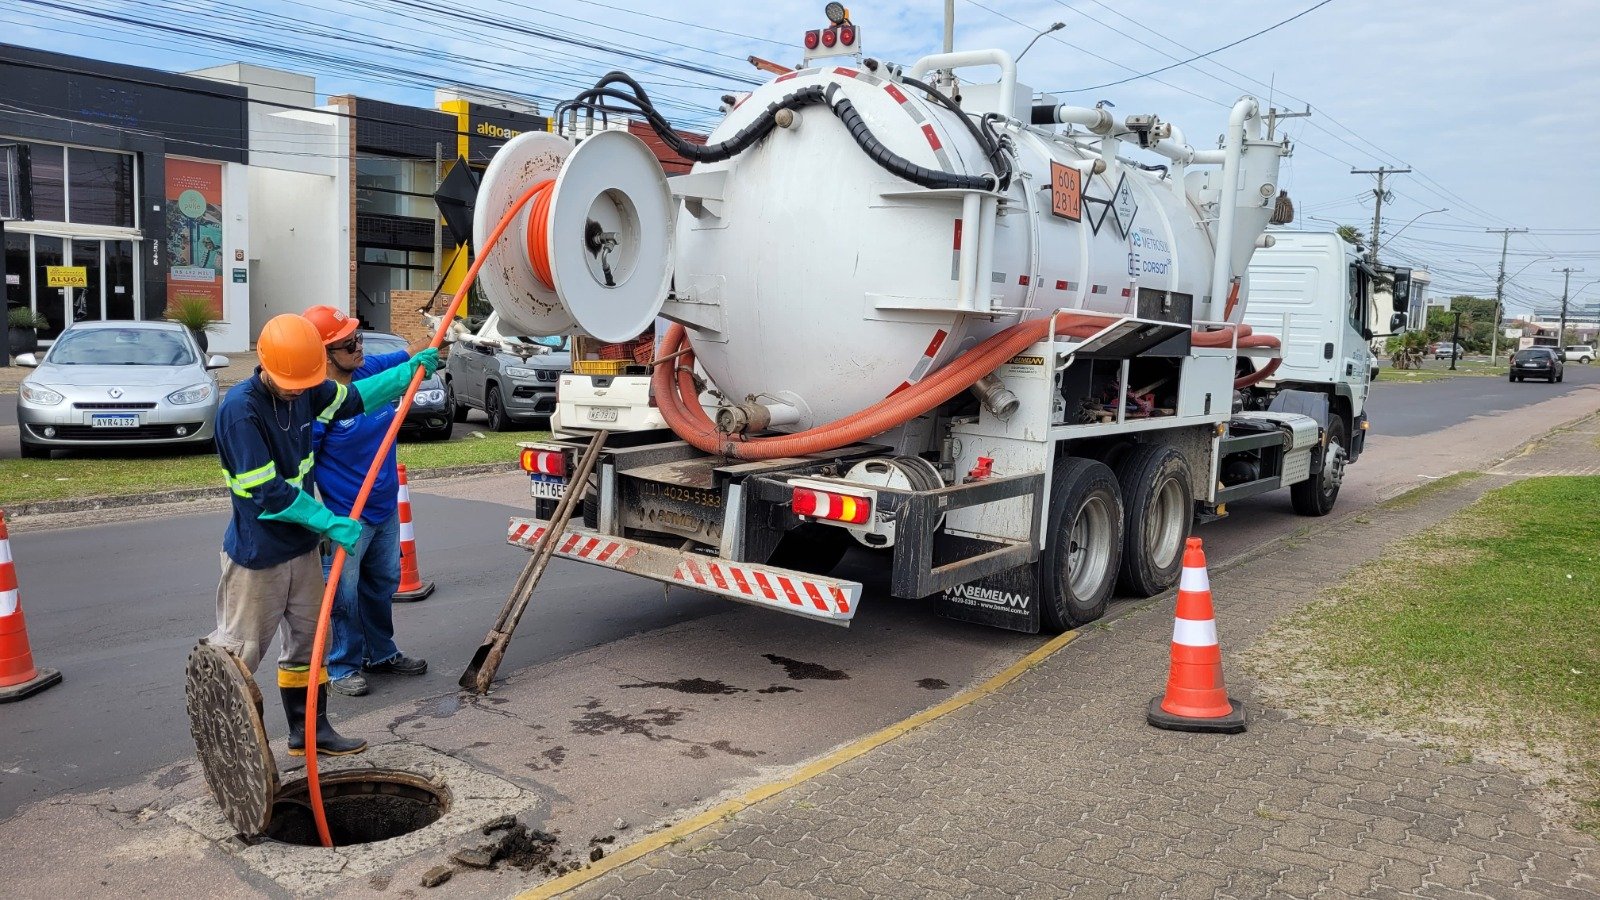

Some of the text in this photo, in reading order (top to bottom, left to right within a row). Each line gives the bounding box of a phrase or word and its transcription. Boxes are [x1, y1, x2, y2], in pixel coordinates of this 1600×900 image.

[477, 121, 523, 138] algoam
[1058, 169, 1075, 191] 606
[1055, 190, 1078, 215] 2814
[97, 418, 134, 426] AYR4132
[663, 486, 721, 508] 4029-5383
